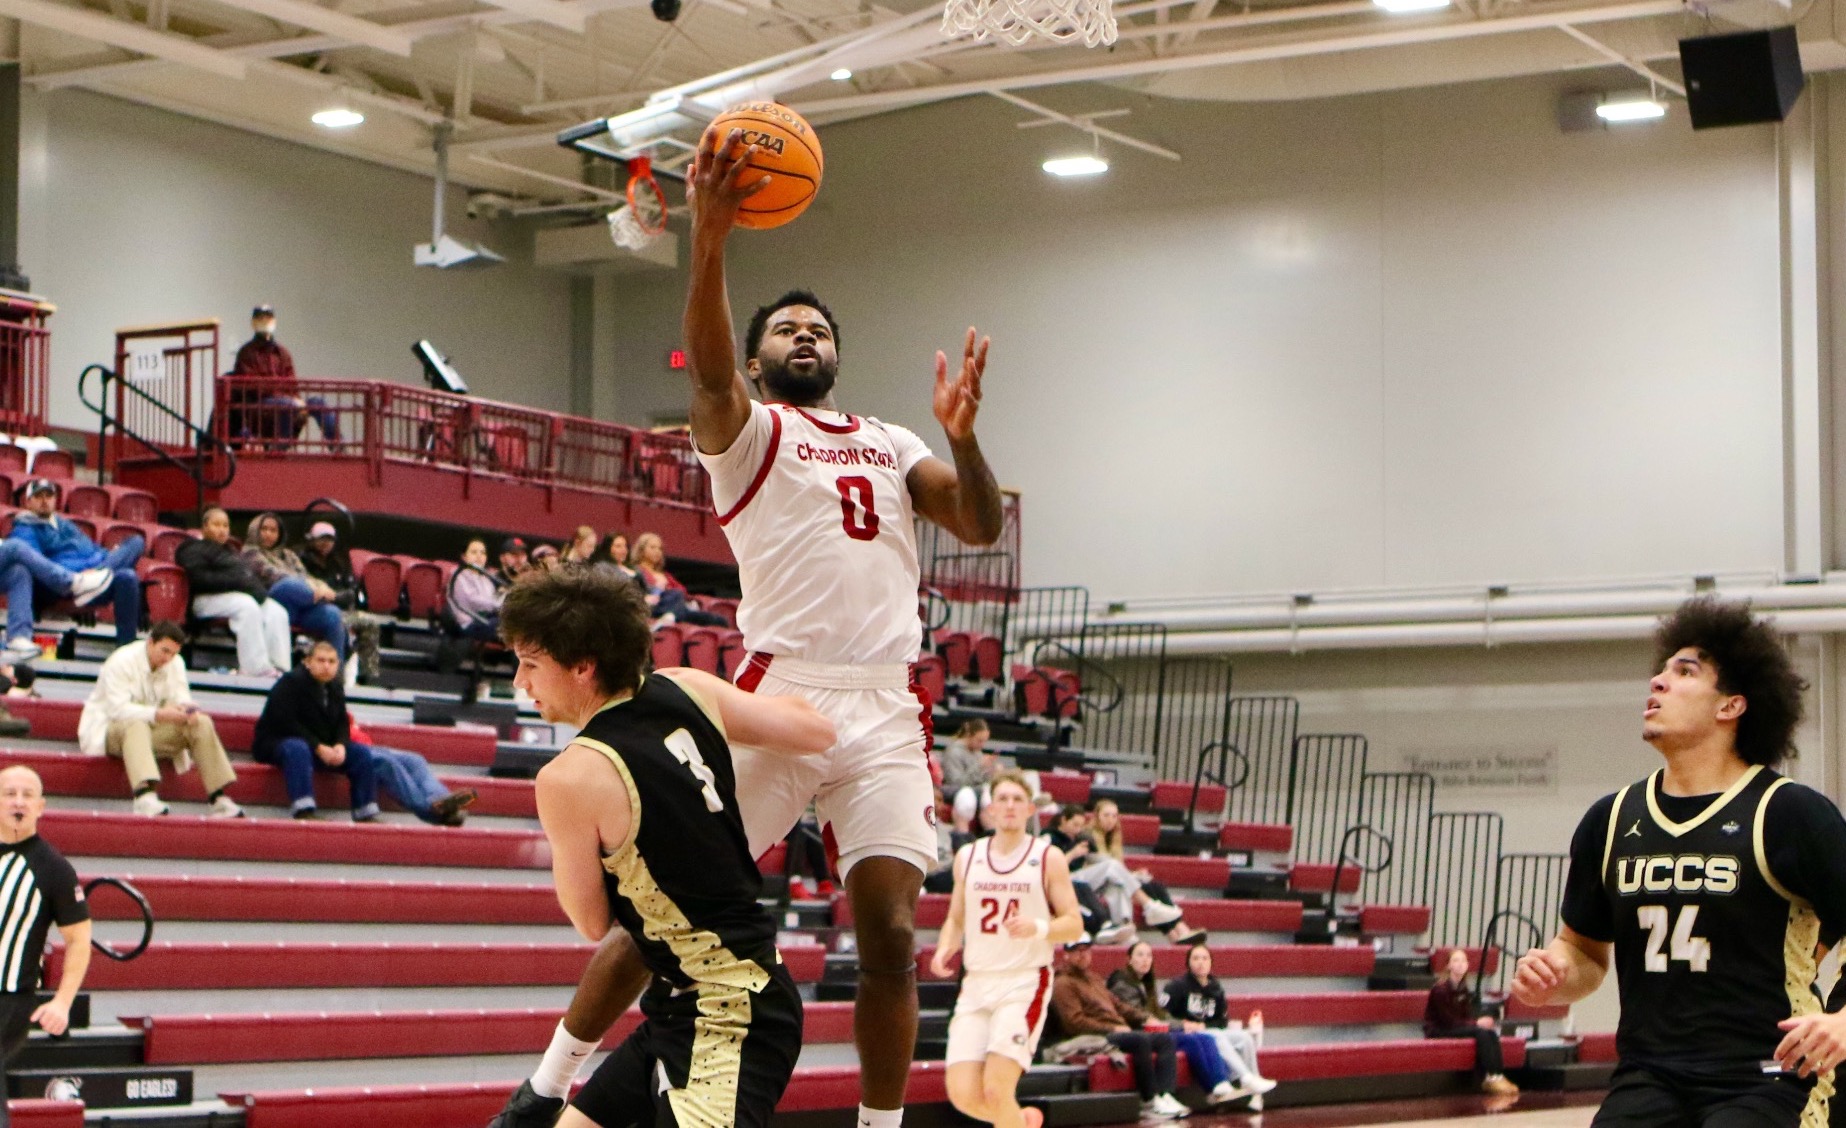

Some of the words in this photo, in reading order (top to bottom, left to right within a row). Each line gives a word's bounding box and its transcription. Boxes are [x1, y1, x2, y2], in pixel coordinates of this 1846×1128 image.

[729, 127, 785, 155] CAA
[137, 353, 158, 370] 113
[835, 475, 880, 542] 0
[663, 726, 725, 814] 3
[973, 881, 1008, 893] CHADRON
[1009, 882, 1032, 894] STATE
[1616, 854, 1741, 895] UCCS
[1636, 904, 1712, 973] 24
[126, 1079, 140, 1099] GO
